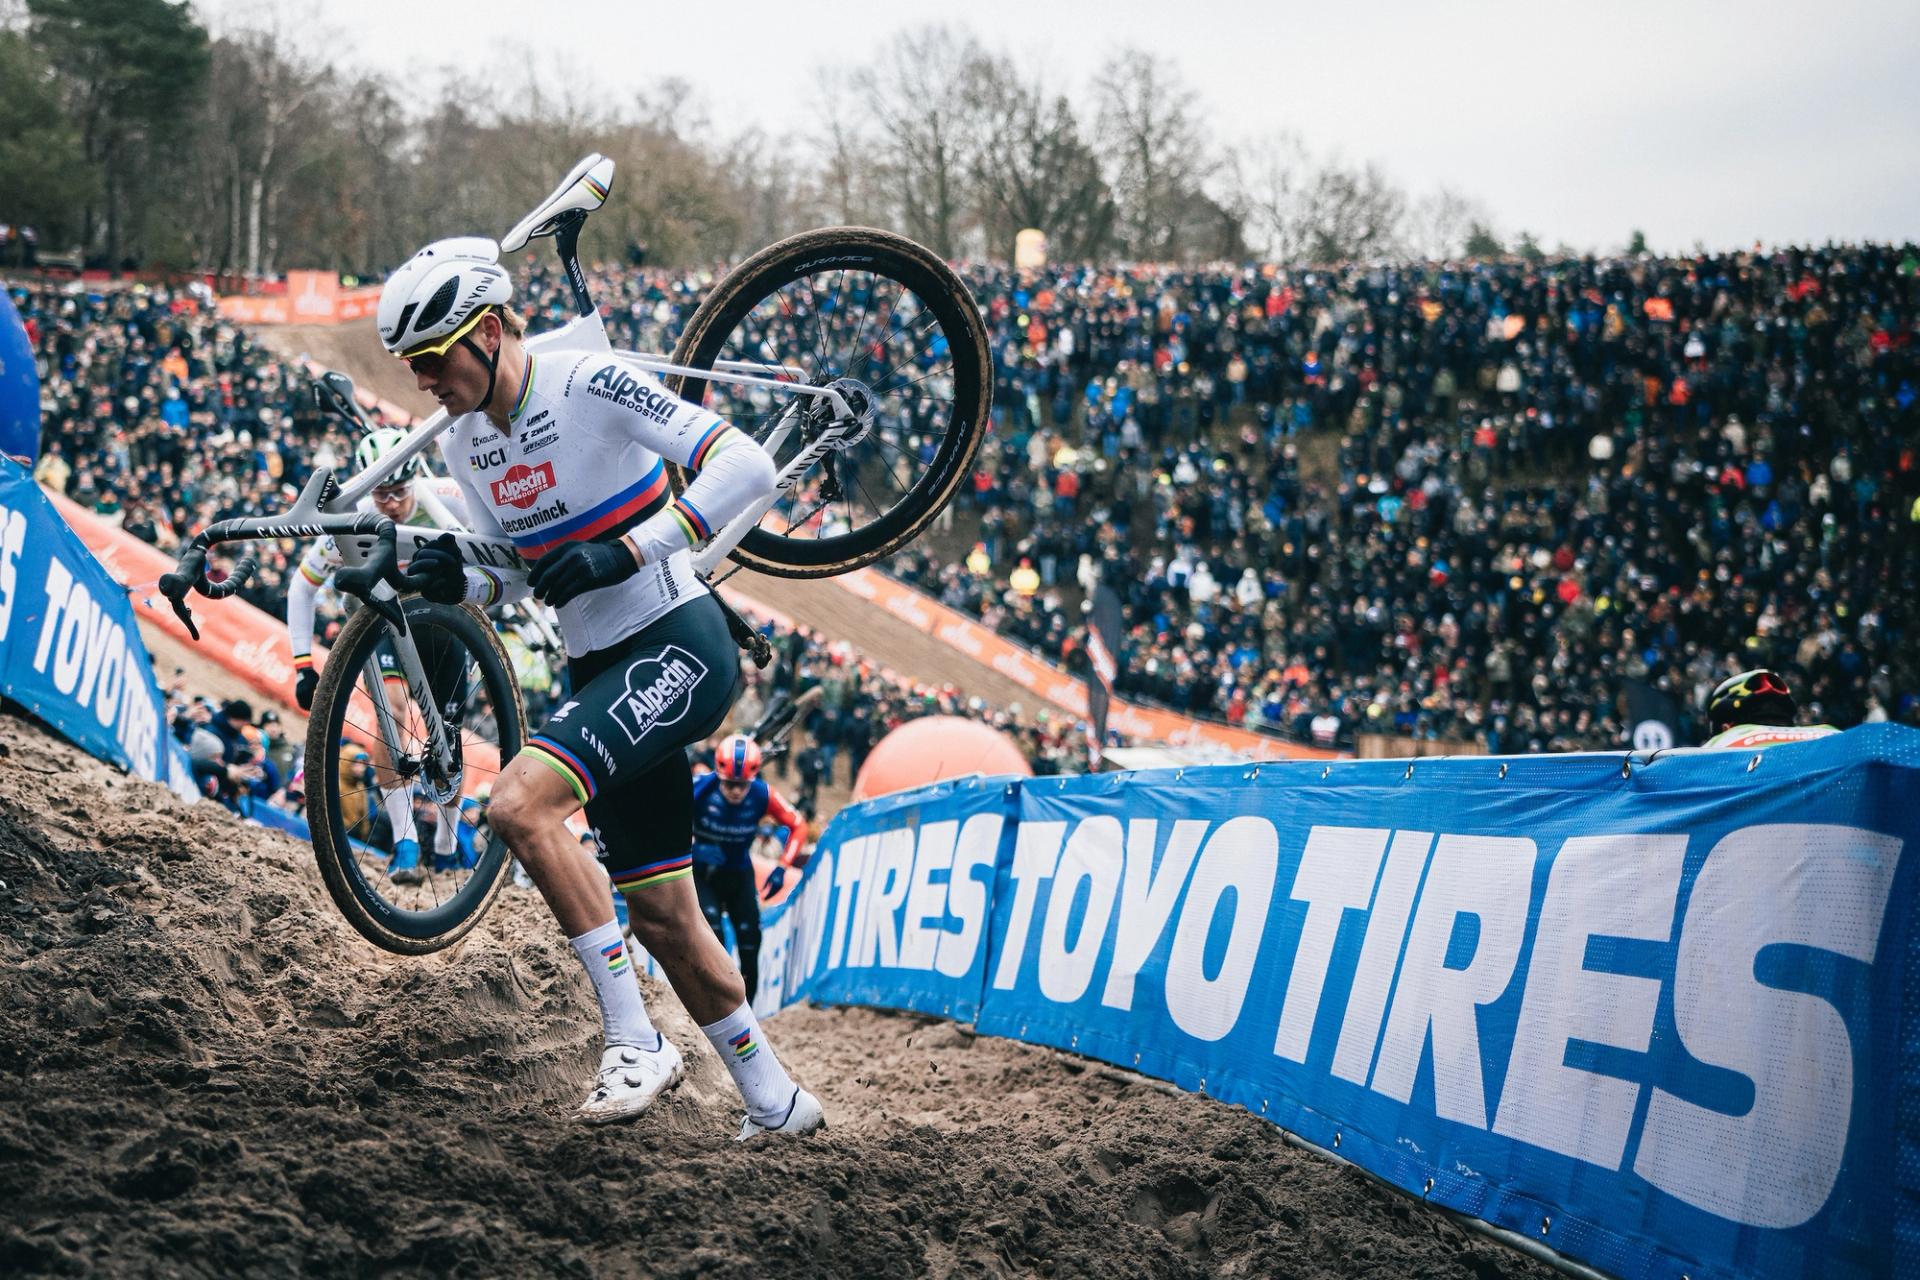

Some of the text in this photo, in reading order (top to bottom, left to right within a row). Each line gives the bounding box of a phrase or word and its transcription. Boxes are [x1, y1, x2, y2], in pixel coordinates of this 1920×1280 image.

[569, 256, 584, 293] CANYON
[793, 254, 874, 273] DURA-ACE
[445, 276, 496, 326] CANYON
[586, 383, 669, 427] HAIR BOOSTER
[589, 364, 679, 419] Alpecin
[530, 419, 556, 438] ZWIFT
[475, 447, 507, 471] UCI
[776, 424, 848, 490] CANYON
[927, 420, 967, 497] DURA-ACE
[316, 471, 336, 512] CANYON
[498, 469, 547, 499] Alpecin
[256, 523, 326, 539] CANYON
[500, 498, 570, 533] deceuninck
[33, 555, 126, 728] TOYO
[626, 657, 693, 726] Alpecin
[639, 672, 699, 732] HAIR BOOSTER
[581, 726, 618, 777] CANYON
[827, 811, 1005, 980] TIRES
[992, 814, 1279, 1043] TOYO
[1272, 822, 1905, 1230] TIRES
